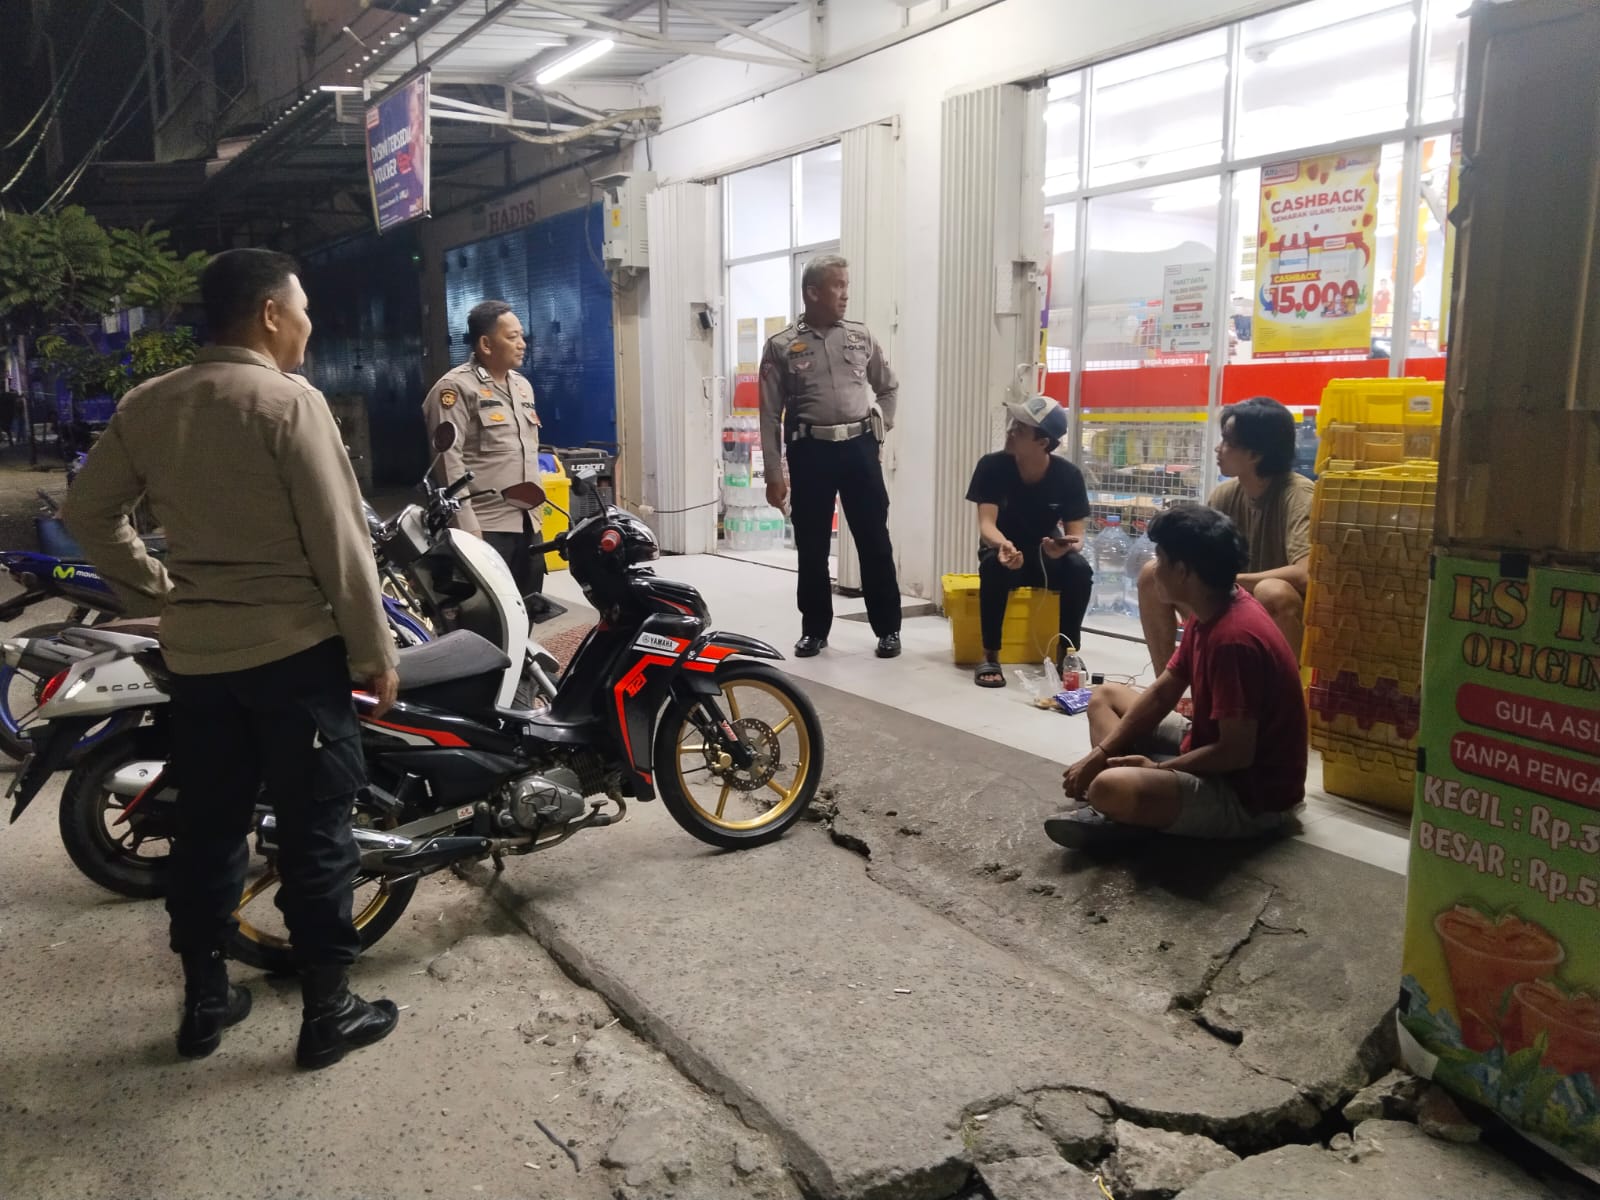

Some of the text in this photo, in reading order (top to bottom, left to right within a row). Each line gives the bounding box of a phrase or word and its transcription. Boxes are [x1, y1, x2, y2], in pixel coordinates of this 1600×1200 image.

[373, 158, 397, 184] VOUCHER
[489, 200, 536, 233] HADIS
[1271, 188, 1366, 214] CASHBACK
[1272, 204, 1363, 223] SEMARAK ULANG TAHUN
[1273, 272, 1318, 284] CASHBACK
[1271, 280, 1360, 314] 15.000
[1450, 573, 1529, 629] ES
[650, 636, 673, 648] YAMAHA
[1495, 701, 1555, 732] GULA
[1453, 739, 1520, 774] TANPA
[1424, 775, 1505, 828] KECIL
[1420, 821, 1505, 878] BESAR
